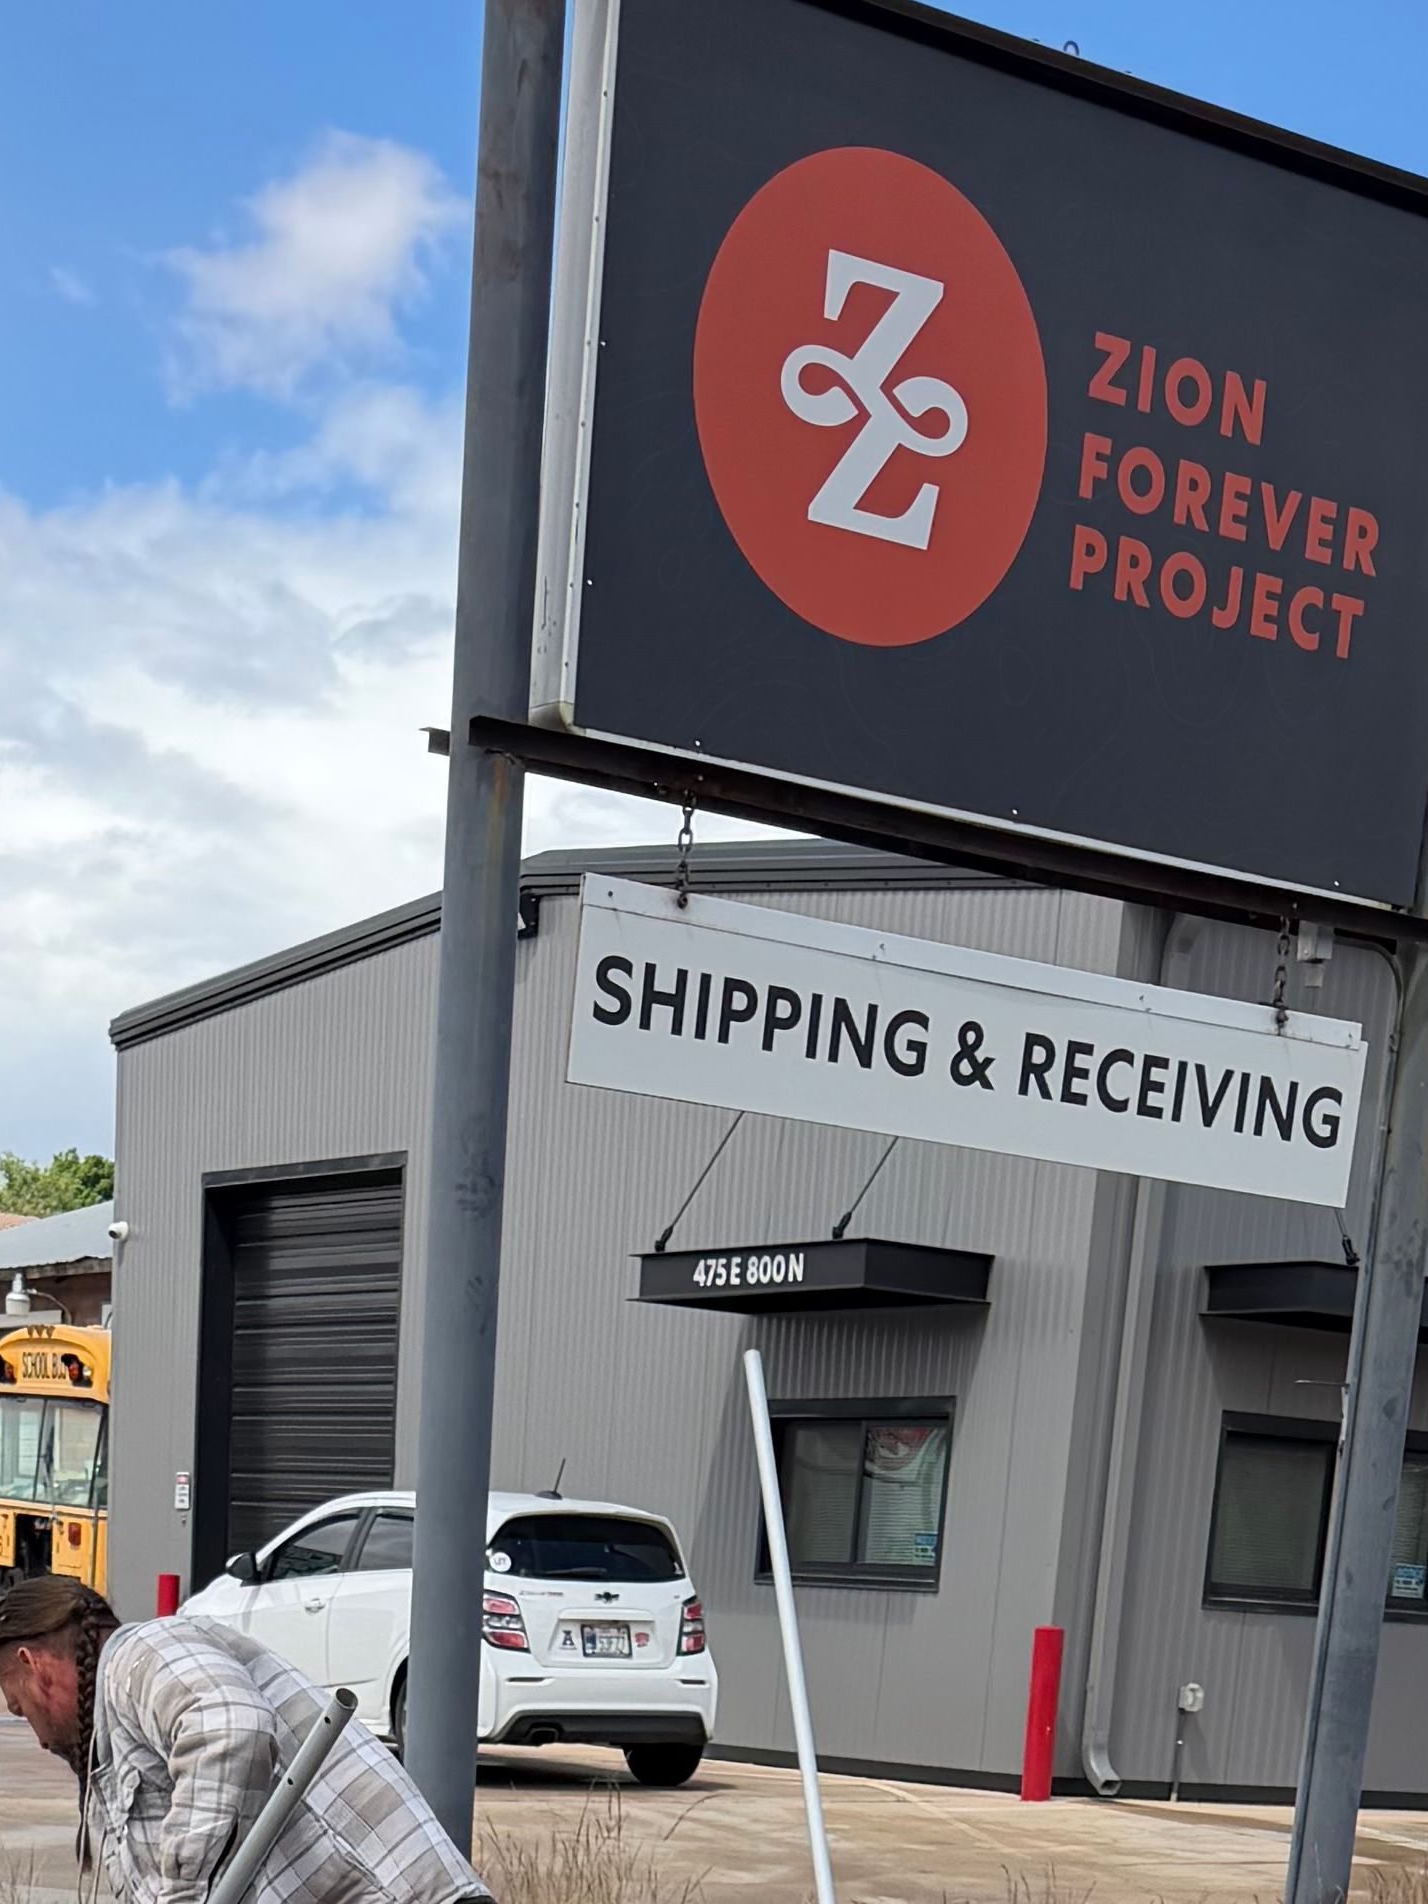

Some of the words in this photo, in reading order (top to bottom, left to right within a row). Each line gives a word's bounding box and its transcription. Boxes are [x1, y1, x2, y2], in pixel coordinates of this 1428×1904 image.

[1086, 331, 1268, 447] ZION
[1078, 432, 1380, 577] FOREVER
[1069, 525, 1366, 659] PROJECT
[592, 954, 930, 1077] SHIPPING
[949, 1020, 995, 1091] &
[1018, 1032, 1345, 1150] RECEIVING
[693, 1258, 727, 1287] 475
[730, 1256, 742, 1285] E
[746, 1254, 786, 1285] 800
[787, 1252, 804, 1282] N
[22, 1352, 50, 1379] SCHOOL
